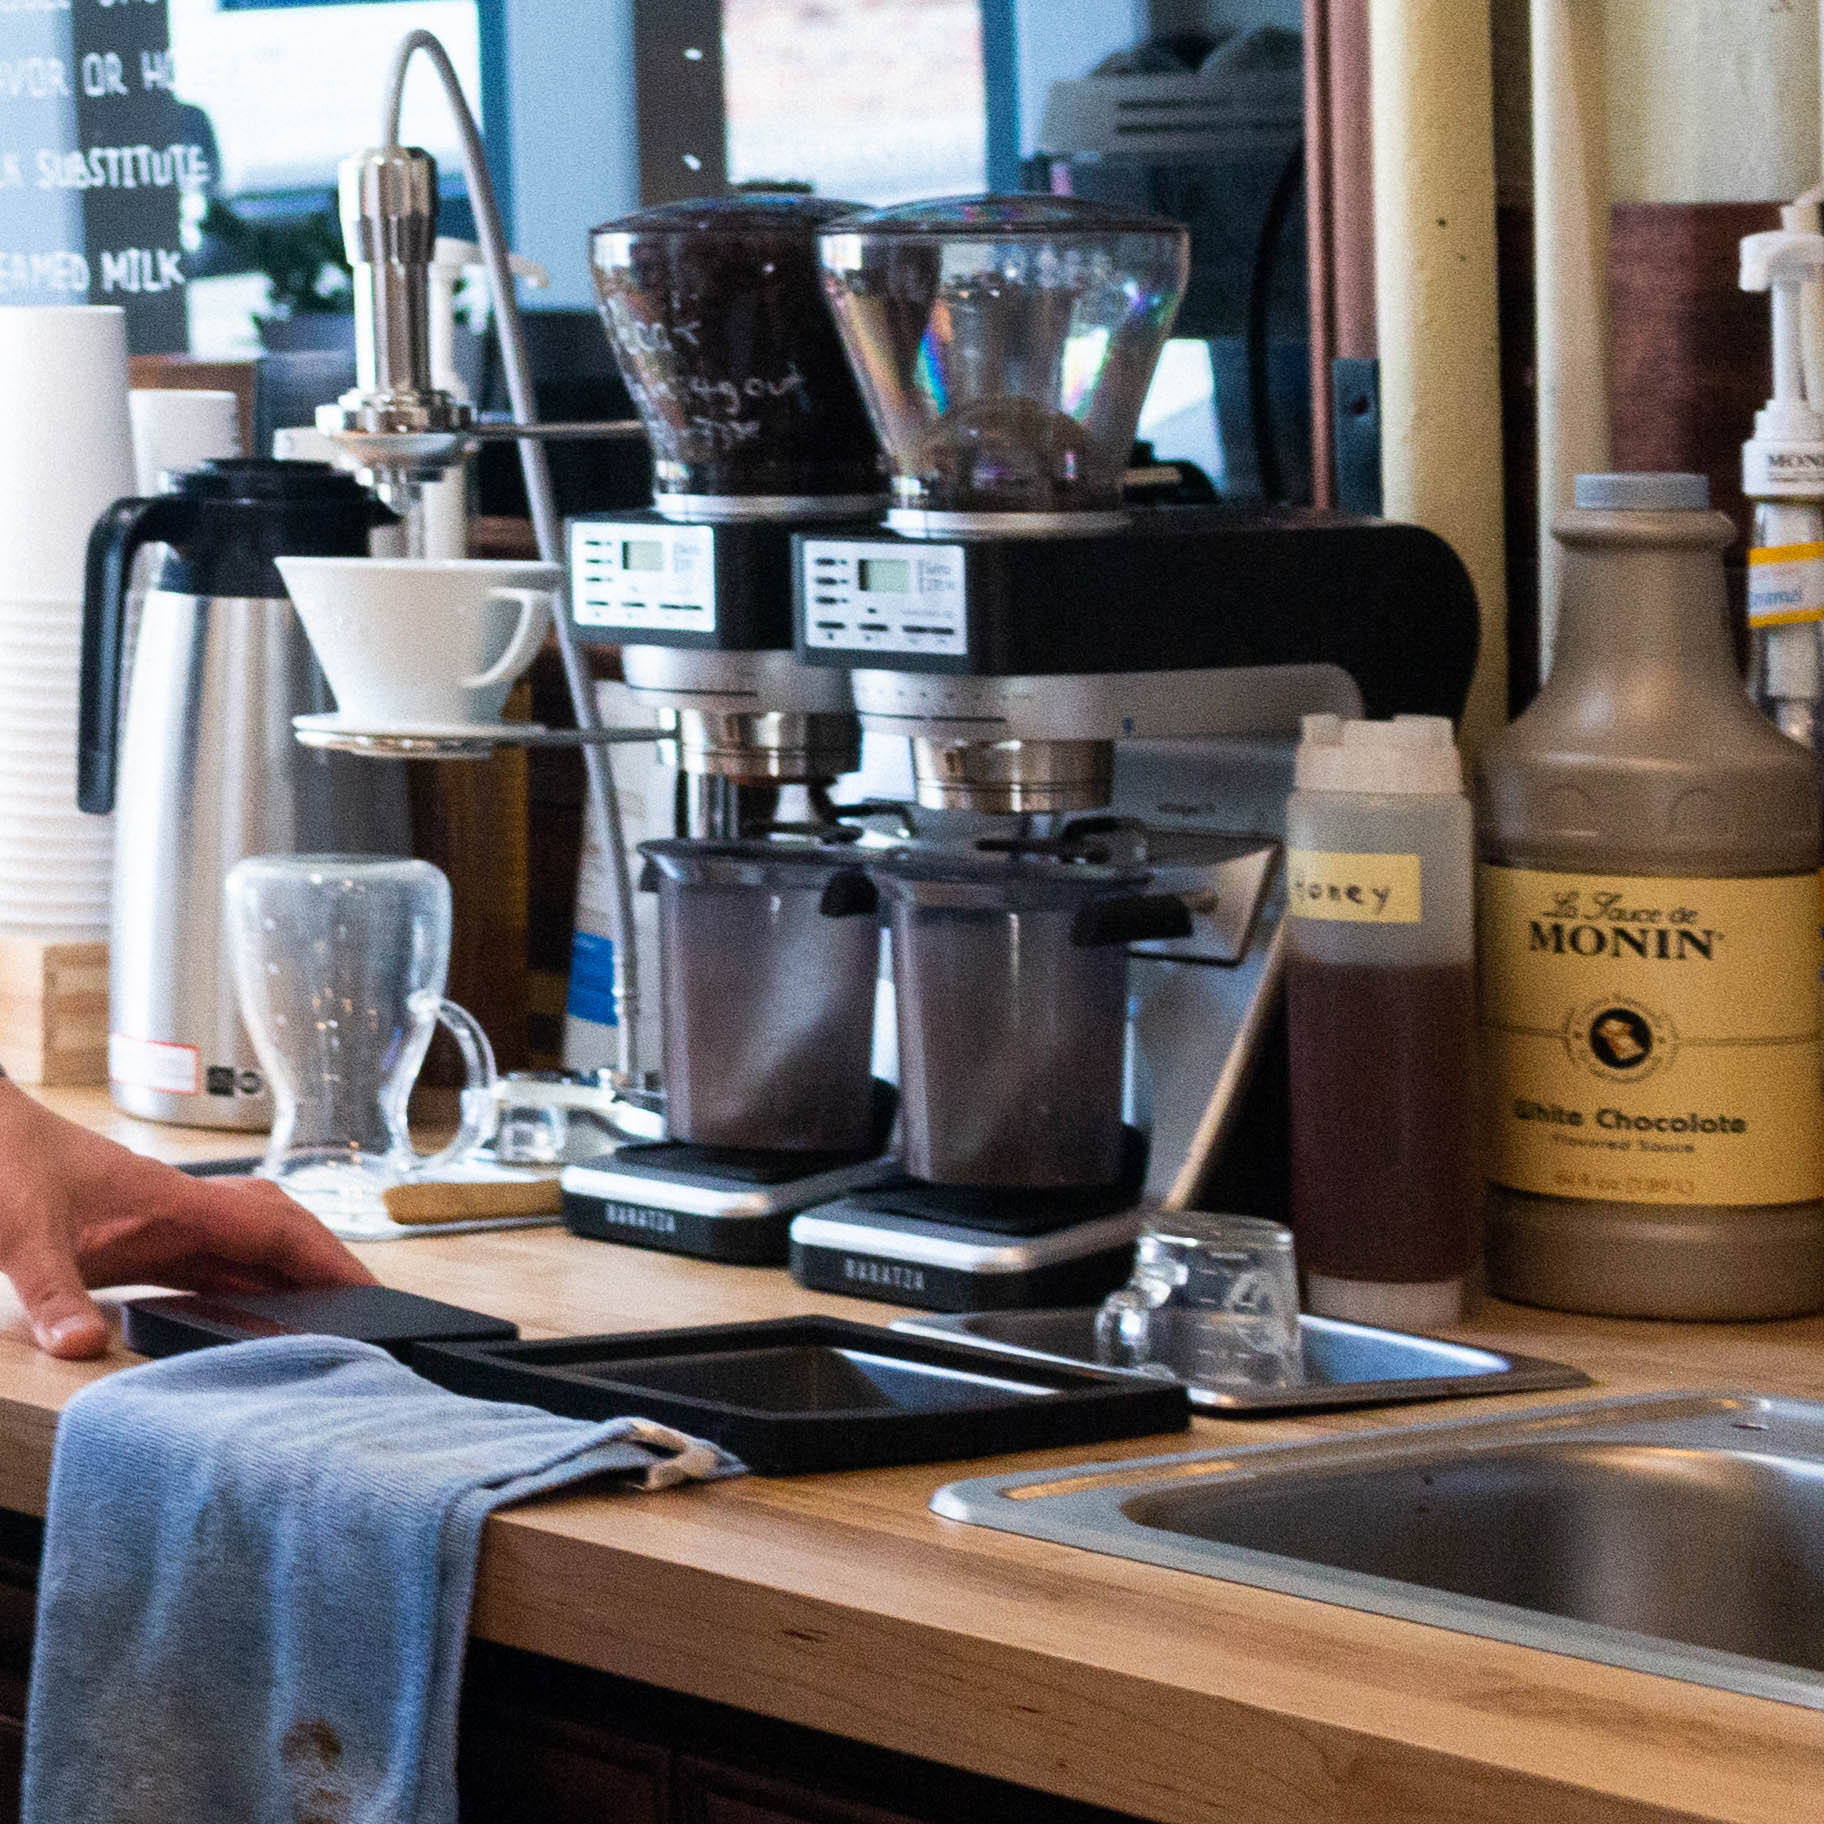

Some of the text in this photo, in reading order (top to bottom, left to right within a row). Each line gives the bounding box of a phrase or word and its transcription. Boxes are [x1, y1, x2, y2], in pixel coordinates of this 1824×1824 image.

[81, 52, 131, 97] OR
[100, 246, 186, 294] MILK
[1528, 919, 1715, 961] MONIN
[1595, 1106, 1748, 1135] Chocolate
